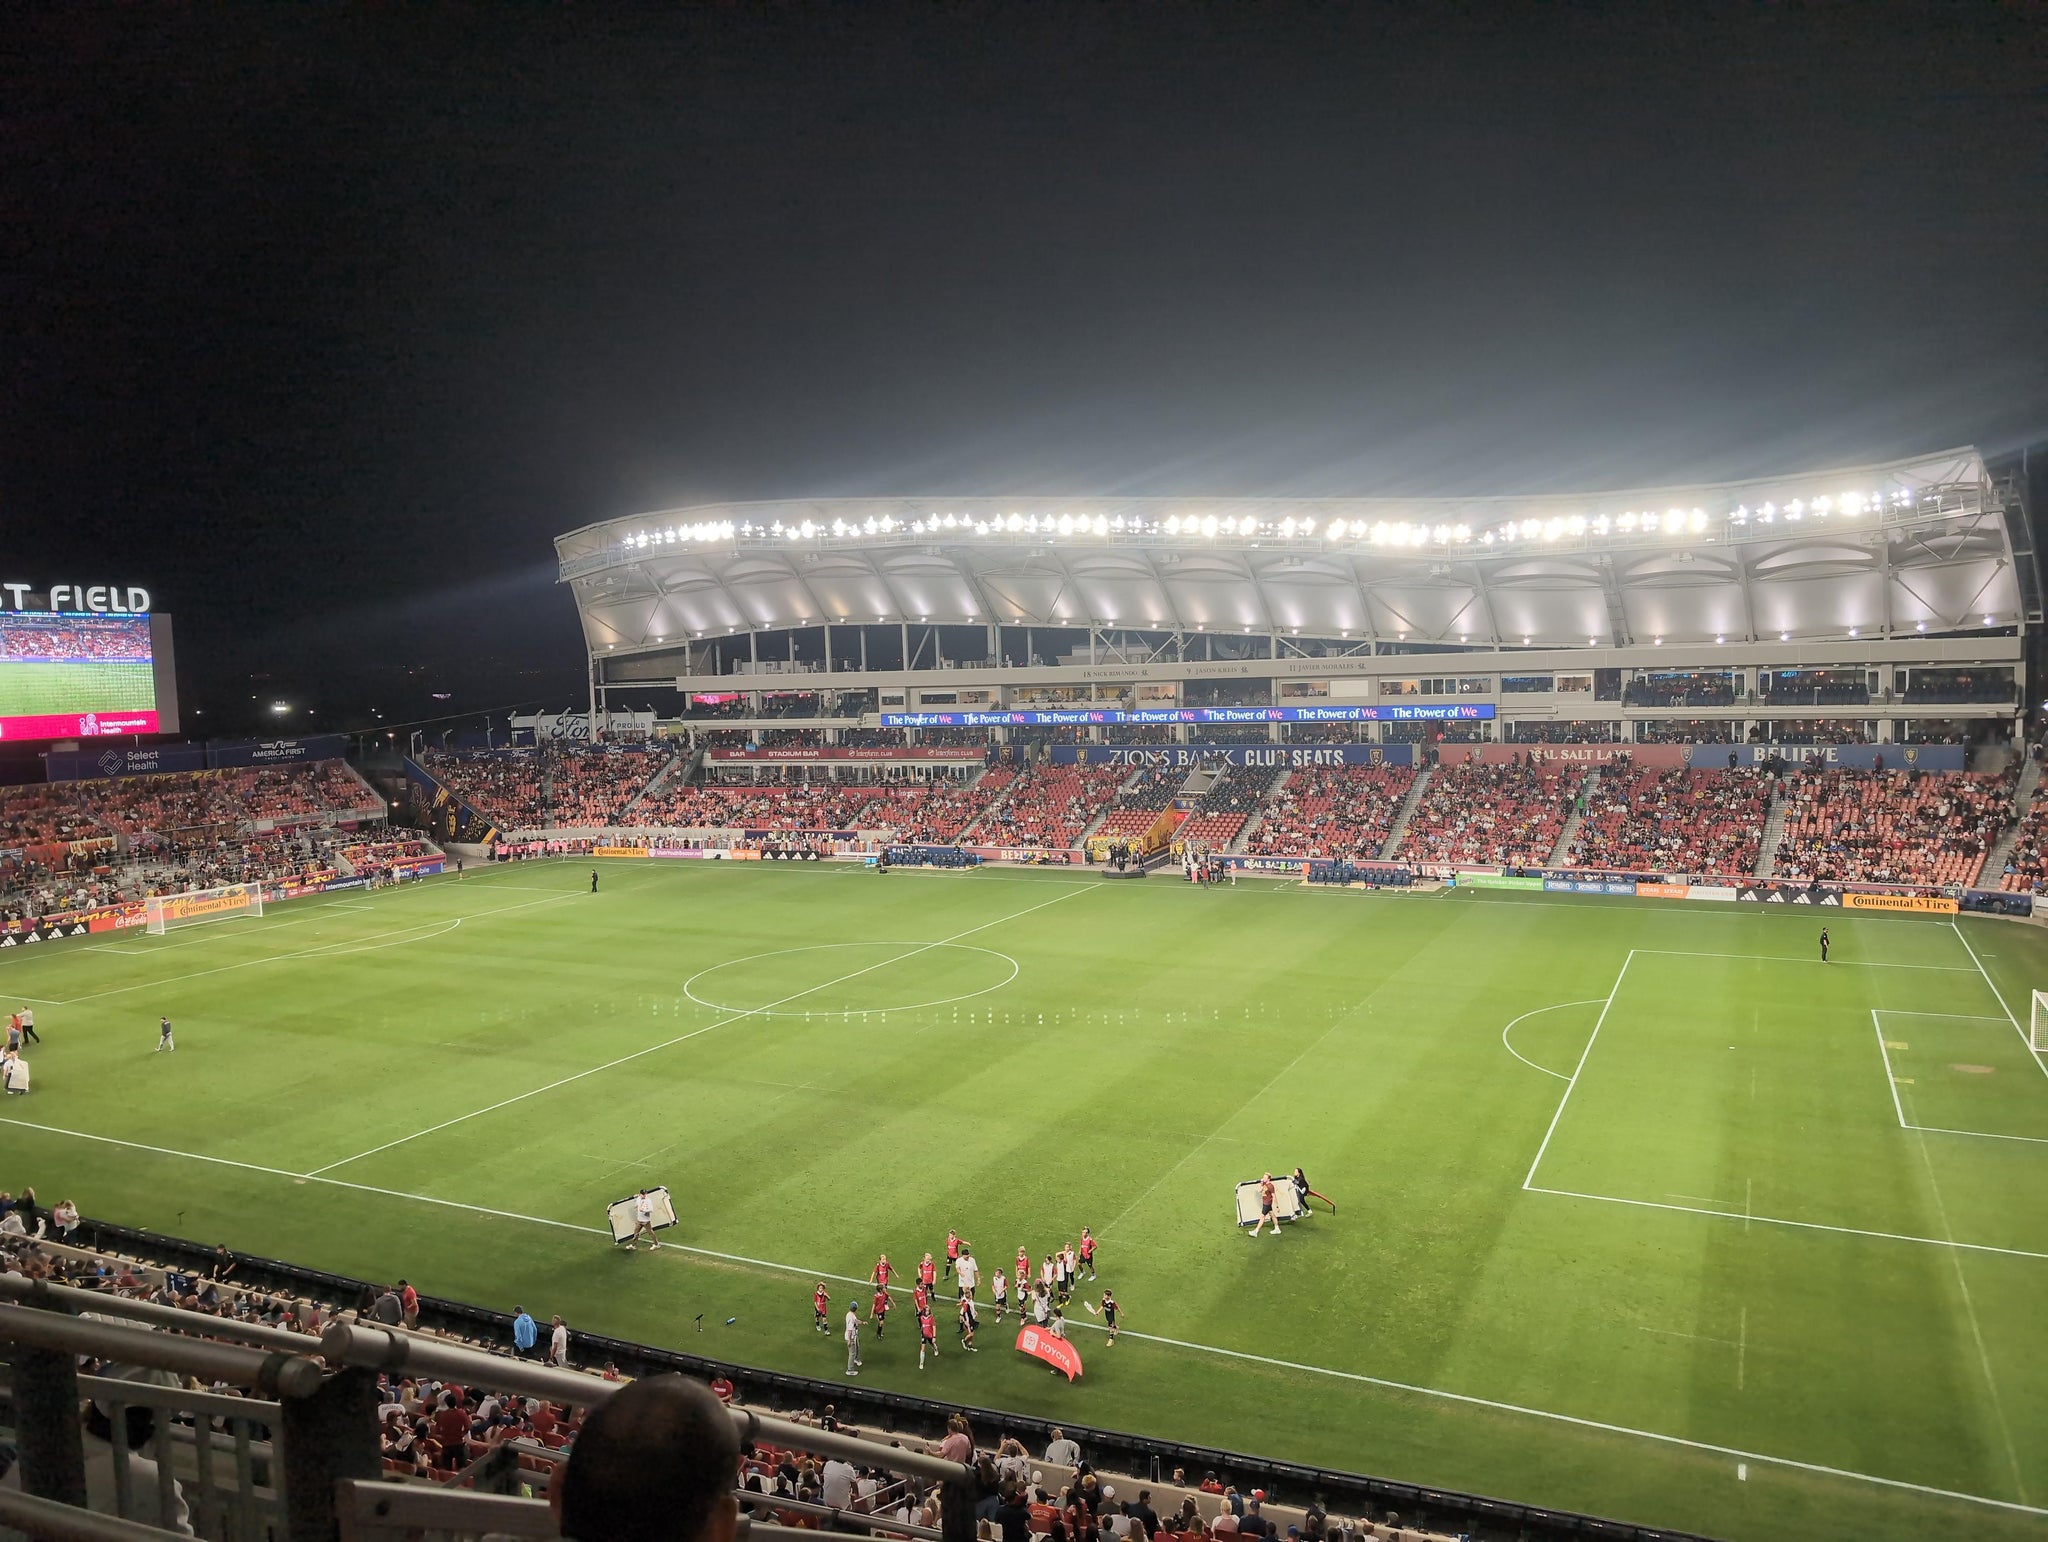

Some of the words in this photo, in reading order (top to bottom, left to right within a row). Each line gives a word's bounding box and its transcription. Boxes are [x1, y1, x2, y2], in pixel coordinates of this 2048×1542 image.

[0, 583, 31, 611] T
[50, 585, 150, 612] FIELD
[1196, 667, 1216, 675] JASON
[1298, 664, 1320, 672] JAVIER
[1036, 713, 1051, 723] The
[1053, 713, 1079, 722] Power
[1080, 712, 1088, 722] of
[1090, 712, 1103, 721] We
[1141, 712, 1168, 721] Power
[1169, 711, 1178, 721] of
[1180, 711, 1194, 720] We
[1208, 710, 1225, 720] The
[1227, 710, 1254, 720] Power
[1256, 709, 1266, 719] of
[1268, 710, 1283, 719] We
[1297, 708, 1315, 719] The
[1317, 709, 1347, 719] Power
[1349, 708, 1360, 718] of
[1362, 708, 1377, 718] We
[1392, 707, 1412, 718] The
[1414, 707, 1446, 718] Power
[1447, 706, 1460, 717] of
[1461, 707, 1477, 717] We
[100, 719, 147, 727] Intermountain
[888, 714, 903, 725] The
[929, 714, 938, 724] of
[939, 714, 952, 724] We
[980, 714, 1000, 724] Power
[1001, 713, 1010, 723] of
[1012, 713, 1024, 723] We
[101, 727, 122, 735] Health
[127, 750, 159, 761] Select
[252, 749, 285, 758] AMERICA
[286, 747, 306, 755] FIRST
[1109, 749, 1171, 766] ZIONS
[1292, 749, 1344, 766] SEATS
[1560, 749, 1593, 760] SALT
[1596, 749, 1633, 760] LAKE
[1754, 747, 1838, 762] BELIEVE
[128, 760, 158, 771] Health
[1001, 850, 1041, 860] BELIE
[325, 879, 361, 891] Intermountain
[180, 901, 221, 916] Continental
[228, 896, 246, 907] Tire
[1853, 895, 1913, 908] Continental
[1926, 897, 1950, 910] Tire
[1040, 1341, 1070, 1369] TOYOTA
